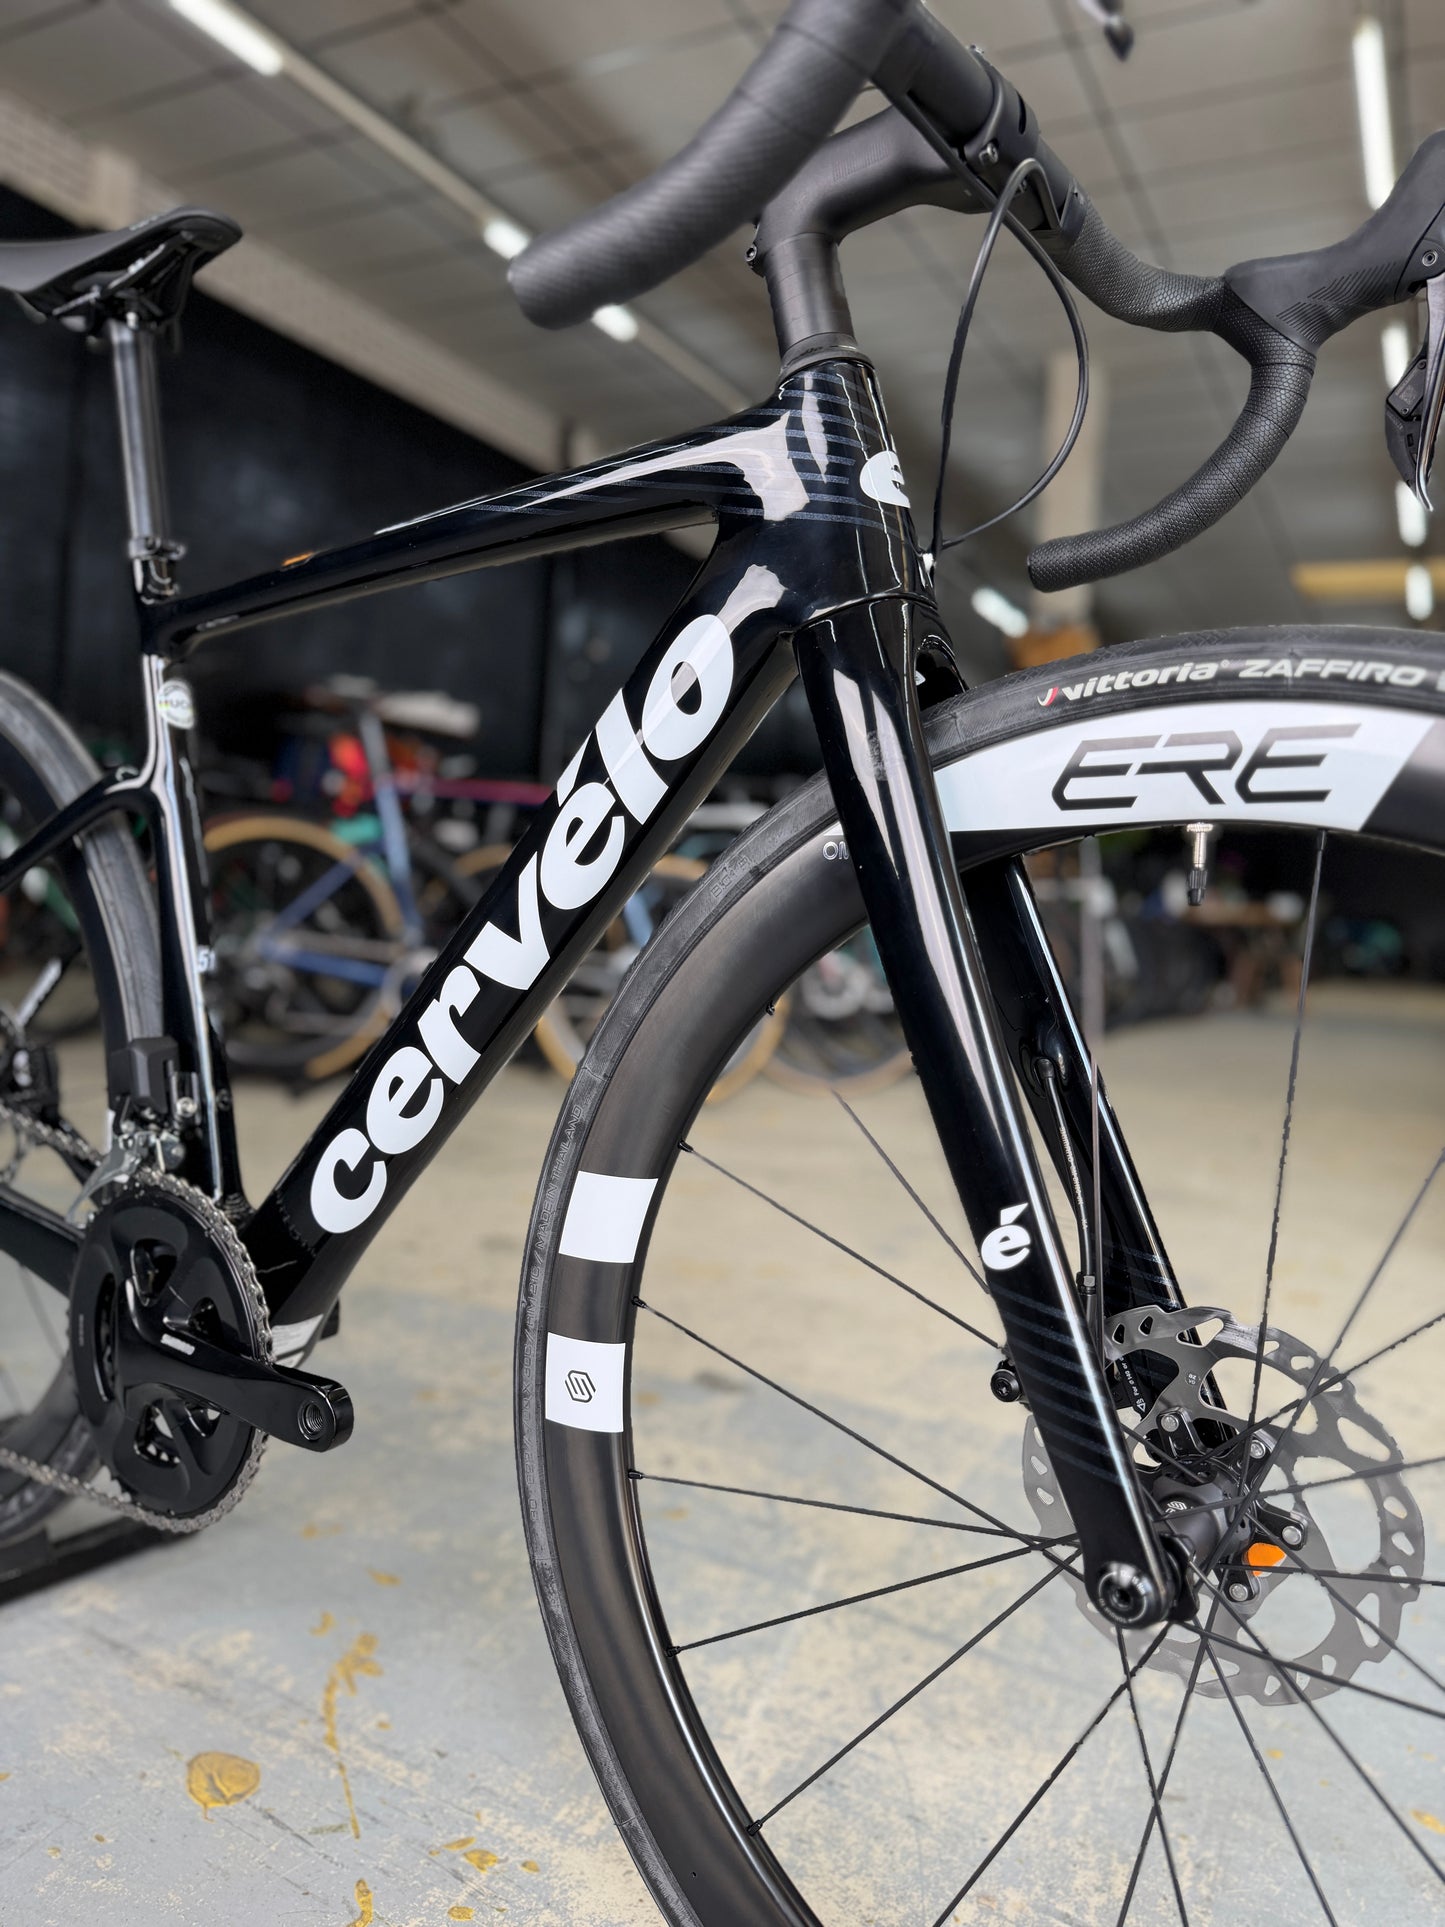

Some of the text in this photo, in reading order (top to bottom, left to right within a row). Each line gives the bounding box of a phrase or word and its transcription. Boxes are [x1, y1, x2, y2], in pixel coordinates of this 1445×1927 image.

[1238, 658, 1428, 687] ZAFFIRO
[1052, 723, 1361, 811] ERE
[311, 614, 733, 1233] cervélo
[551, 1104, 581, 1180] THAILAND
[545, 1182, 558, 1199] IN
[535, 1202, 553, 1249] MADE
[981, 1203, 1031, 1270] é
